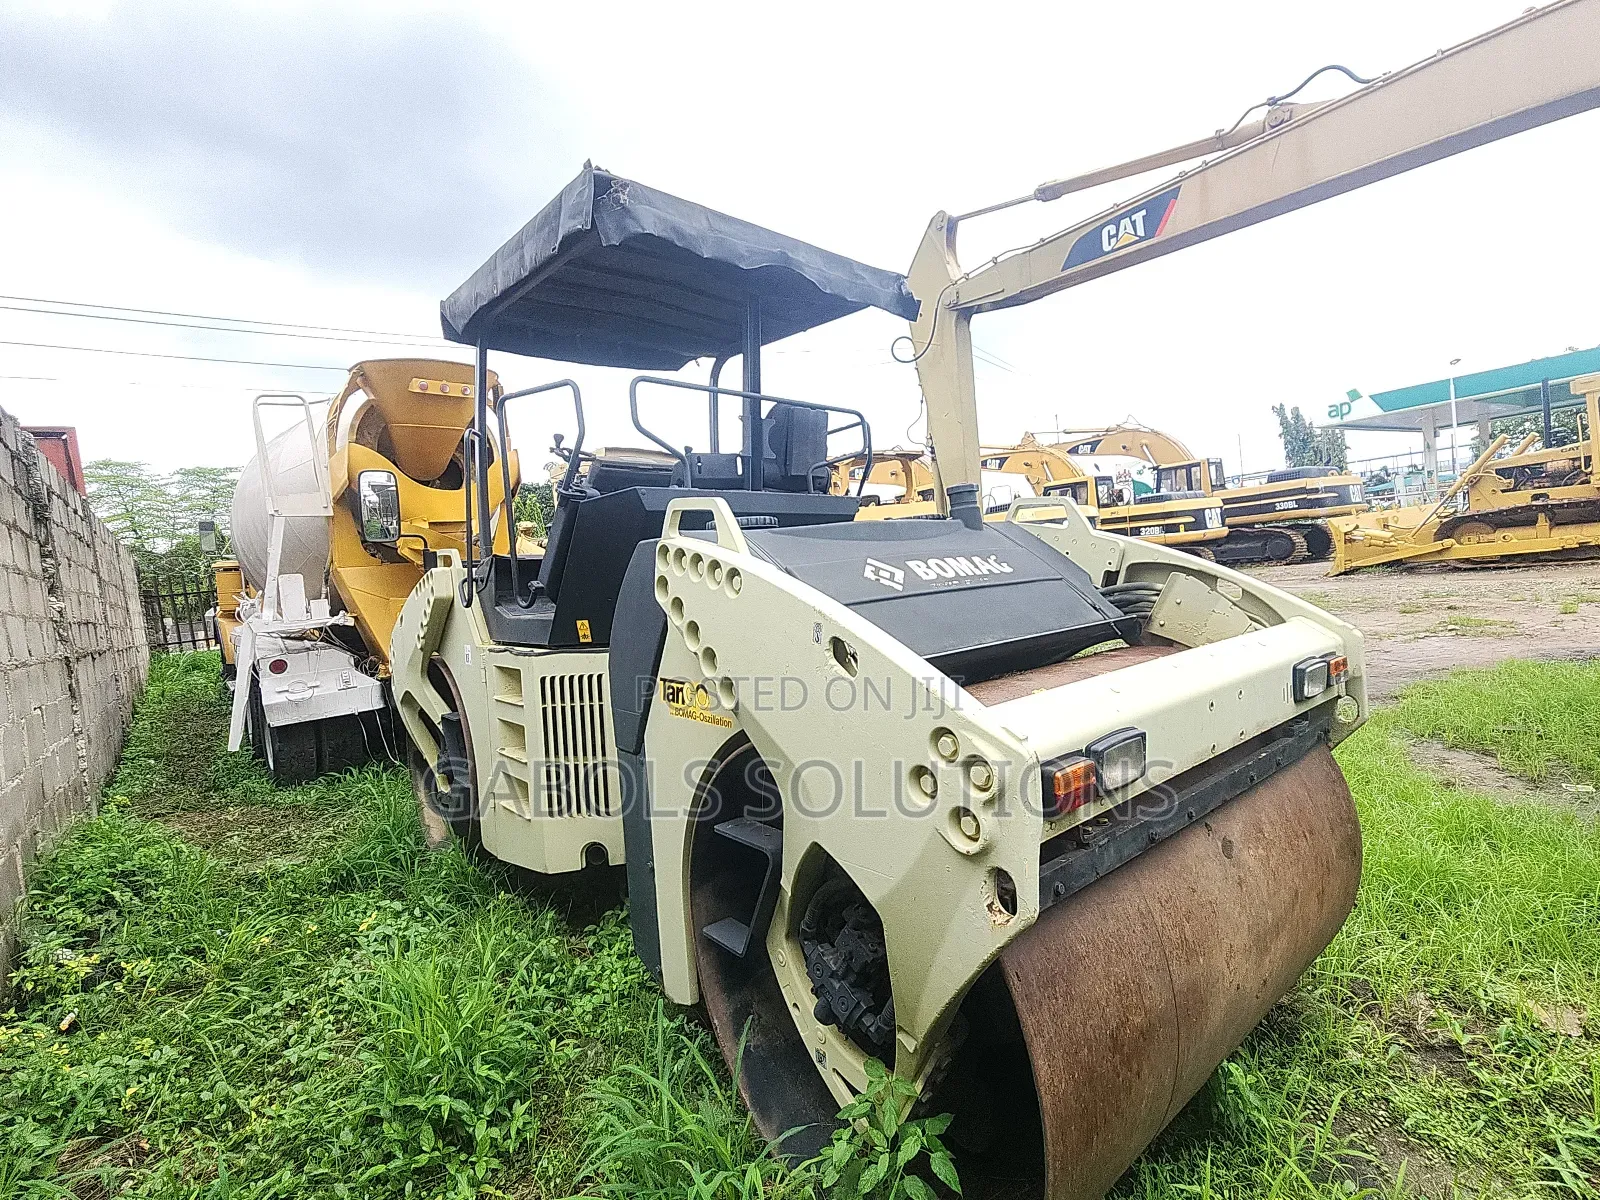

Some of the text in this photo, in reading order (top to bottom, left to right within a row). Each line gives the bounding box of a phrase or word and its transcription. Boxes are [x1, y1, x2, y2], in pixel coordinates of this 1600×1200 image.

[1101, 209, 1147, 252] CAT
[1328, 401, 1352, 420] ap
[1078, 444, 1091, 454] CAT
[987, 458, 1000, 469] CAT
[1349, 484, 1362, 502] CAT
[1275, 501, 1298, 511] 330BL
[1204, 507, 1223, 529] CAT
[905, 554, 1014, 580] BOMAG
